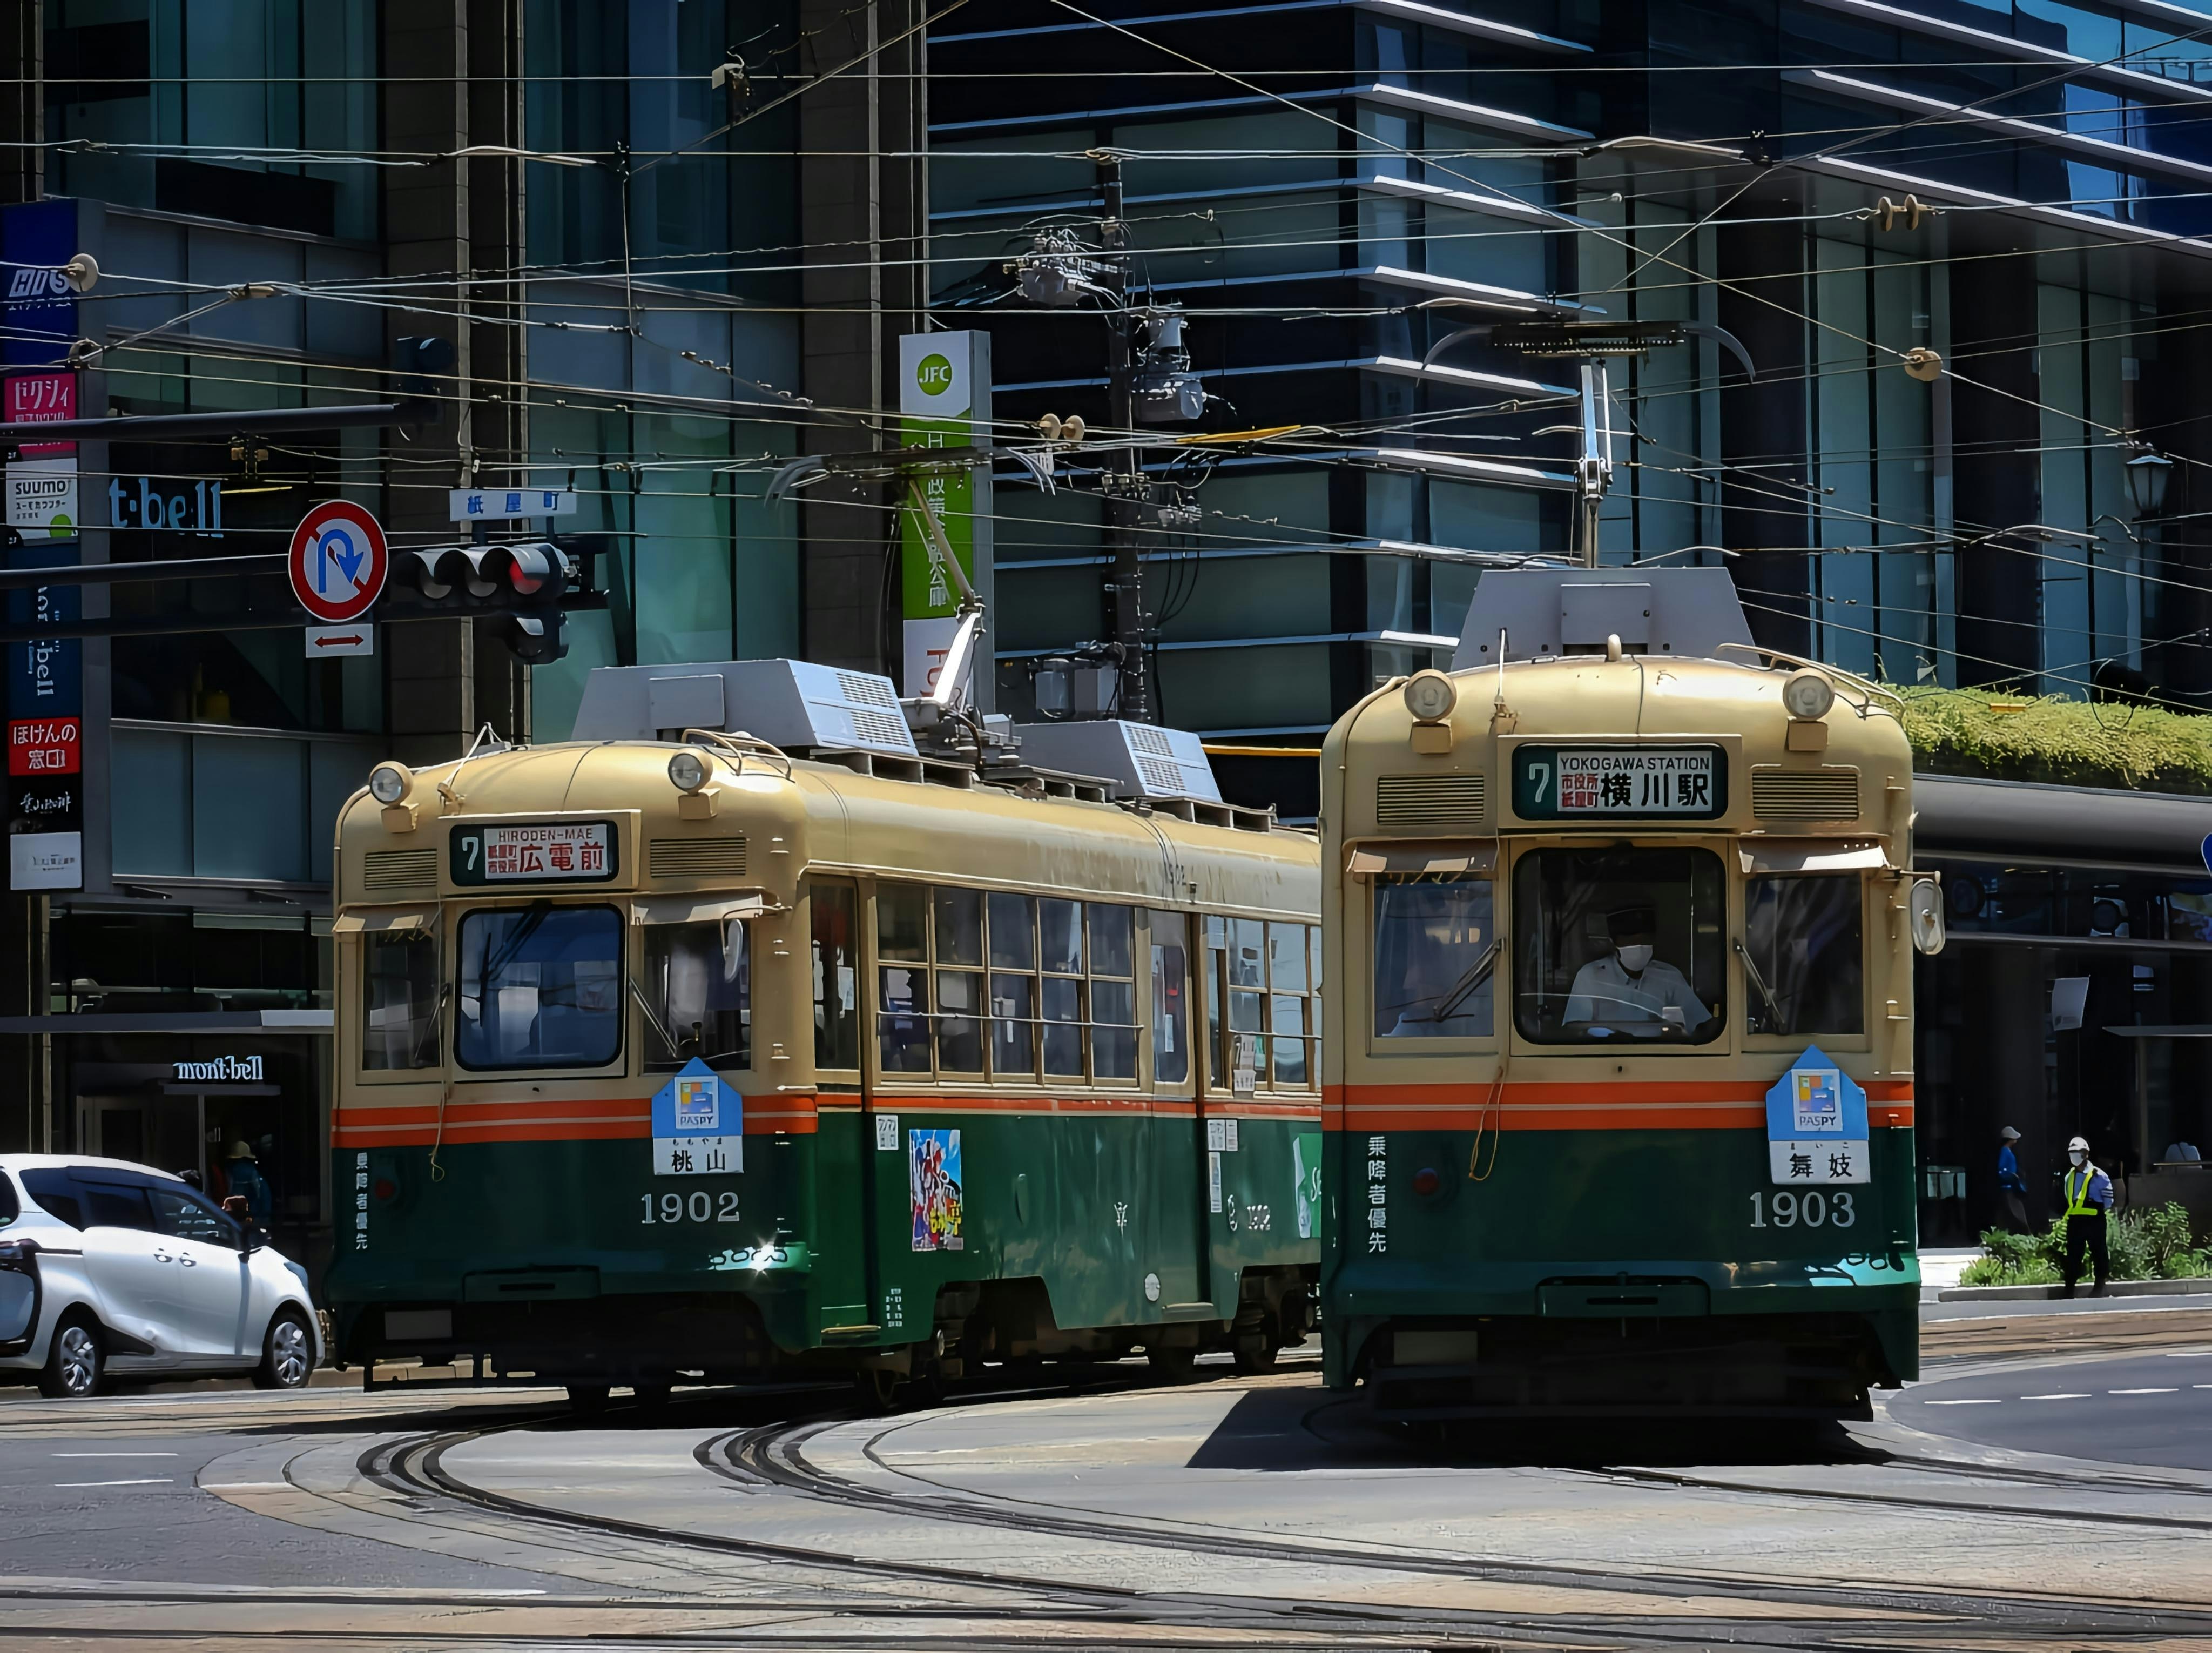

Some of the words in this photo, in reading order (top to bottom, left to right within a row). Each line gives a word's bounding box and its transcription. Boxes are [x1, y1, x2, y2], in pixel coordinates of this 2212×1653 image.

[919, 366, 949, 383] JFC
[16, 480, 66, 495] SUUMO
[14, 724, 76, 744] ほけんの
[29, 749, 65, 769] 窓口
[1561, 758, 1644, 771] YOKOGAWA
[1648, 757, 1709, 770] STATION
[1529, 763, 1549, 803] 7
[1561, 774, 1599, 790] 市役所
[1600, 773, 1709, 807] 横川駅
[498, 828, 593, 842] HIRODEN-MAE
[462, 837, 479, 870] 7
[519, 841, 604, 873] 広電前
[680, 1115, 713, 1125] PASPY
[1800, 1116, 1836, 1126] PASPY
[672, 1148, 726, 1173] 桃山
[1789, 1153, 1853, 1178] 舞妓
[1368, 1136, 1386, 1253] 乗降者優先
[640, 1191, 740, 1224] 1902
[1750, 1192, 1855, 1227] 1903
